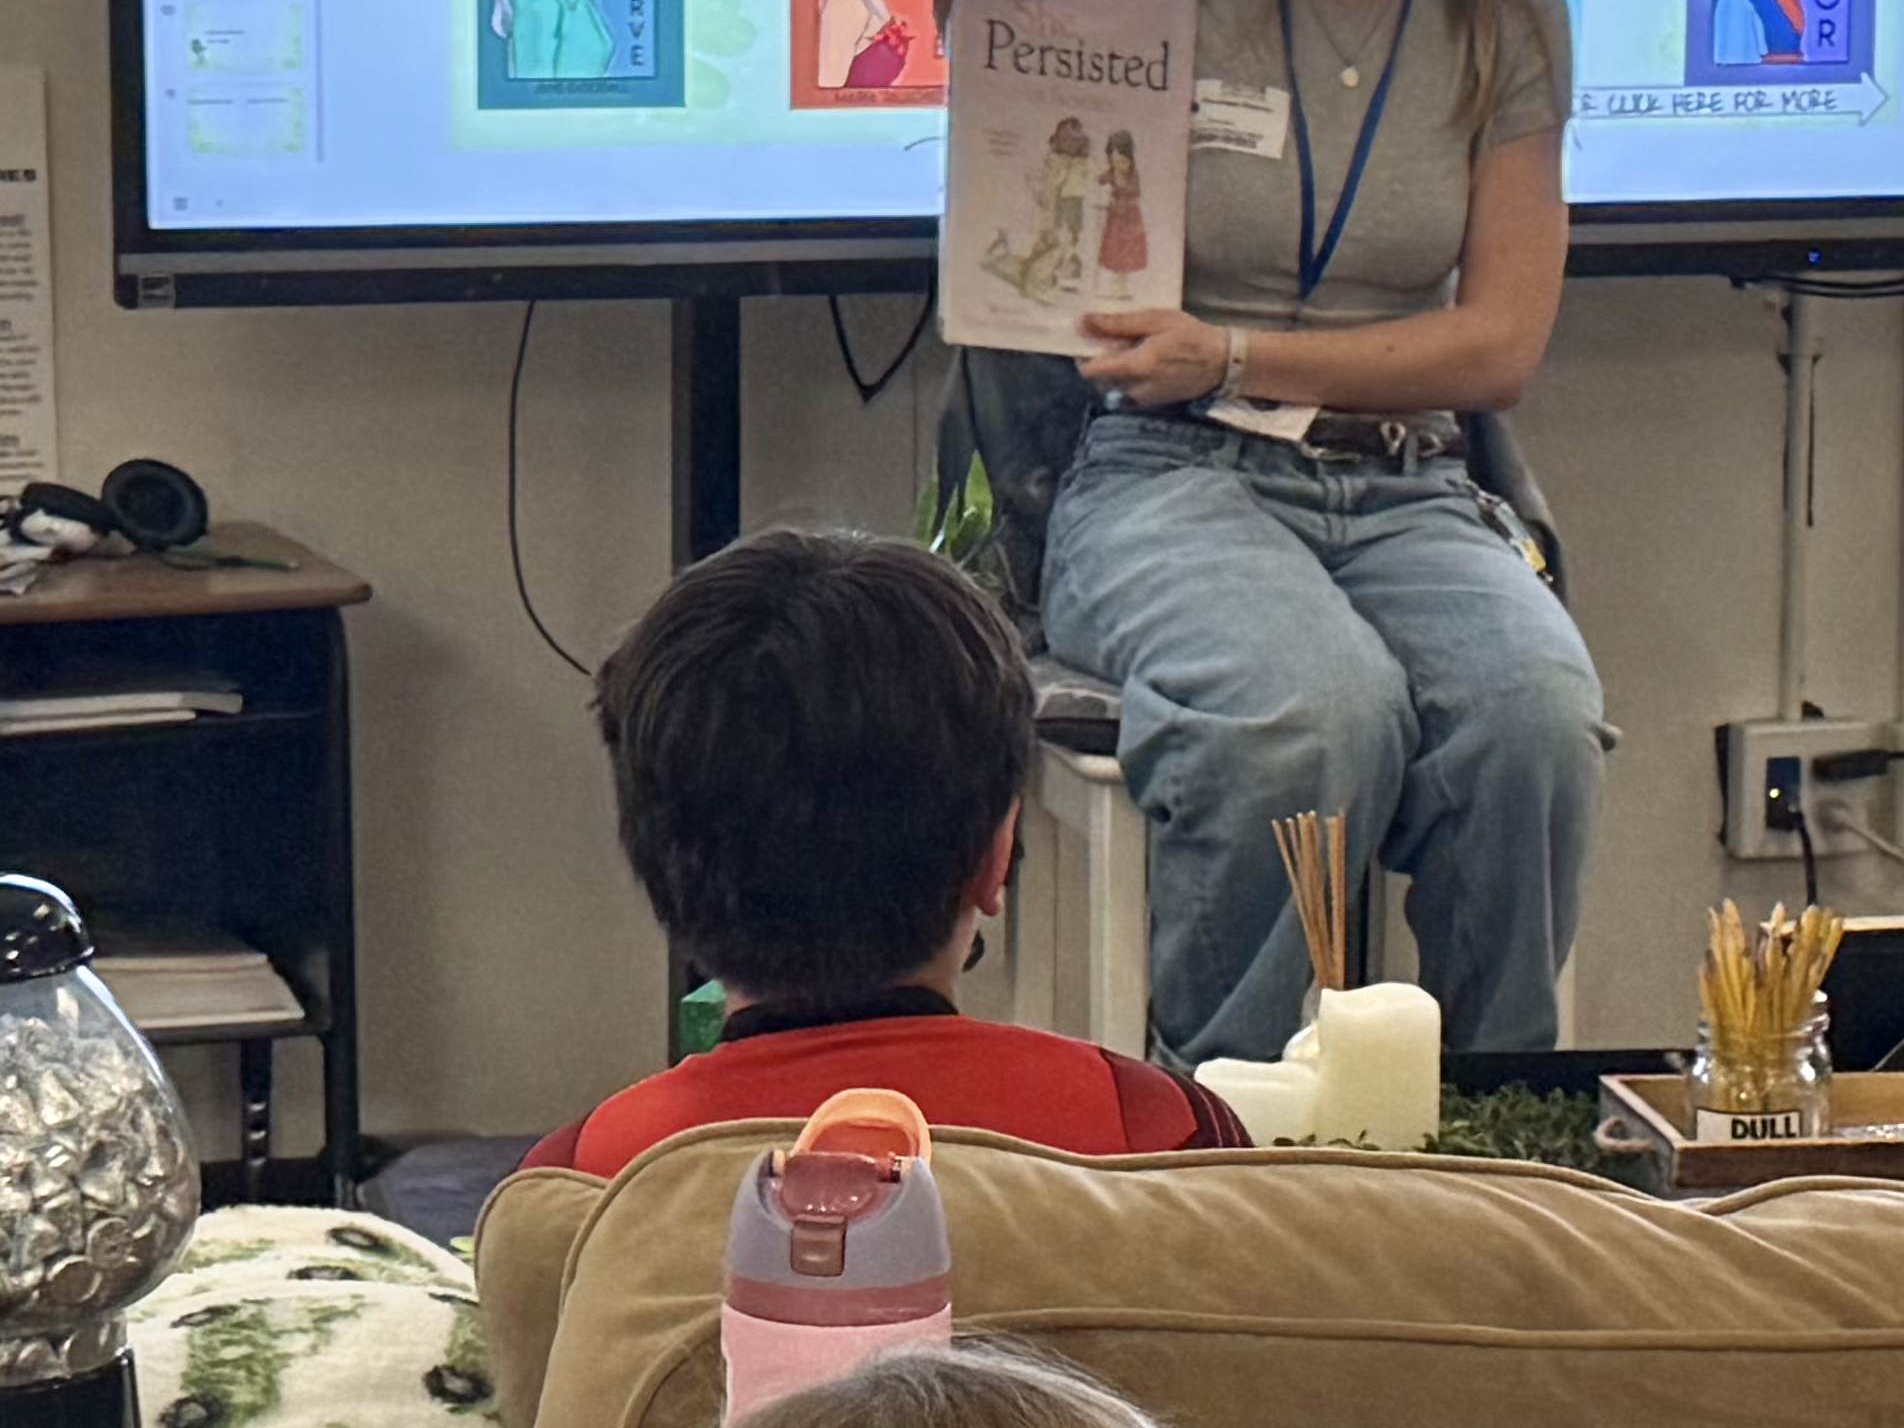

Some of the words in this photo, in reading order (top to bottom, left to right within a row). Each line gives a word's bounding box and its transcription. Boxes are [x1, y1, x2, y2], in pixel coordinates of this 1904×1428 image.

[984, 19, 1170, 92] Persisted
[1673, 91, 1722, 114] HERE
[1735, 90, 1773, 113] FOR
[1782, 90, 1836, 113] MORE
[1731, 1116, 1796, 1140] DULL
